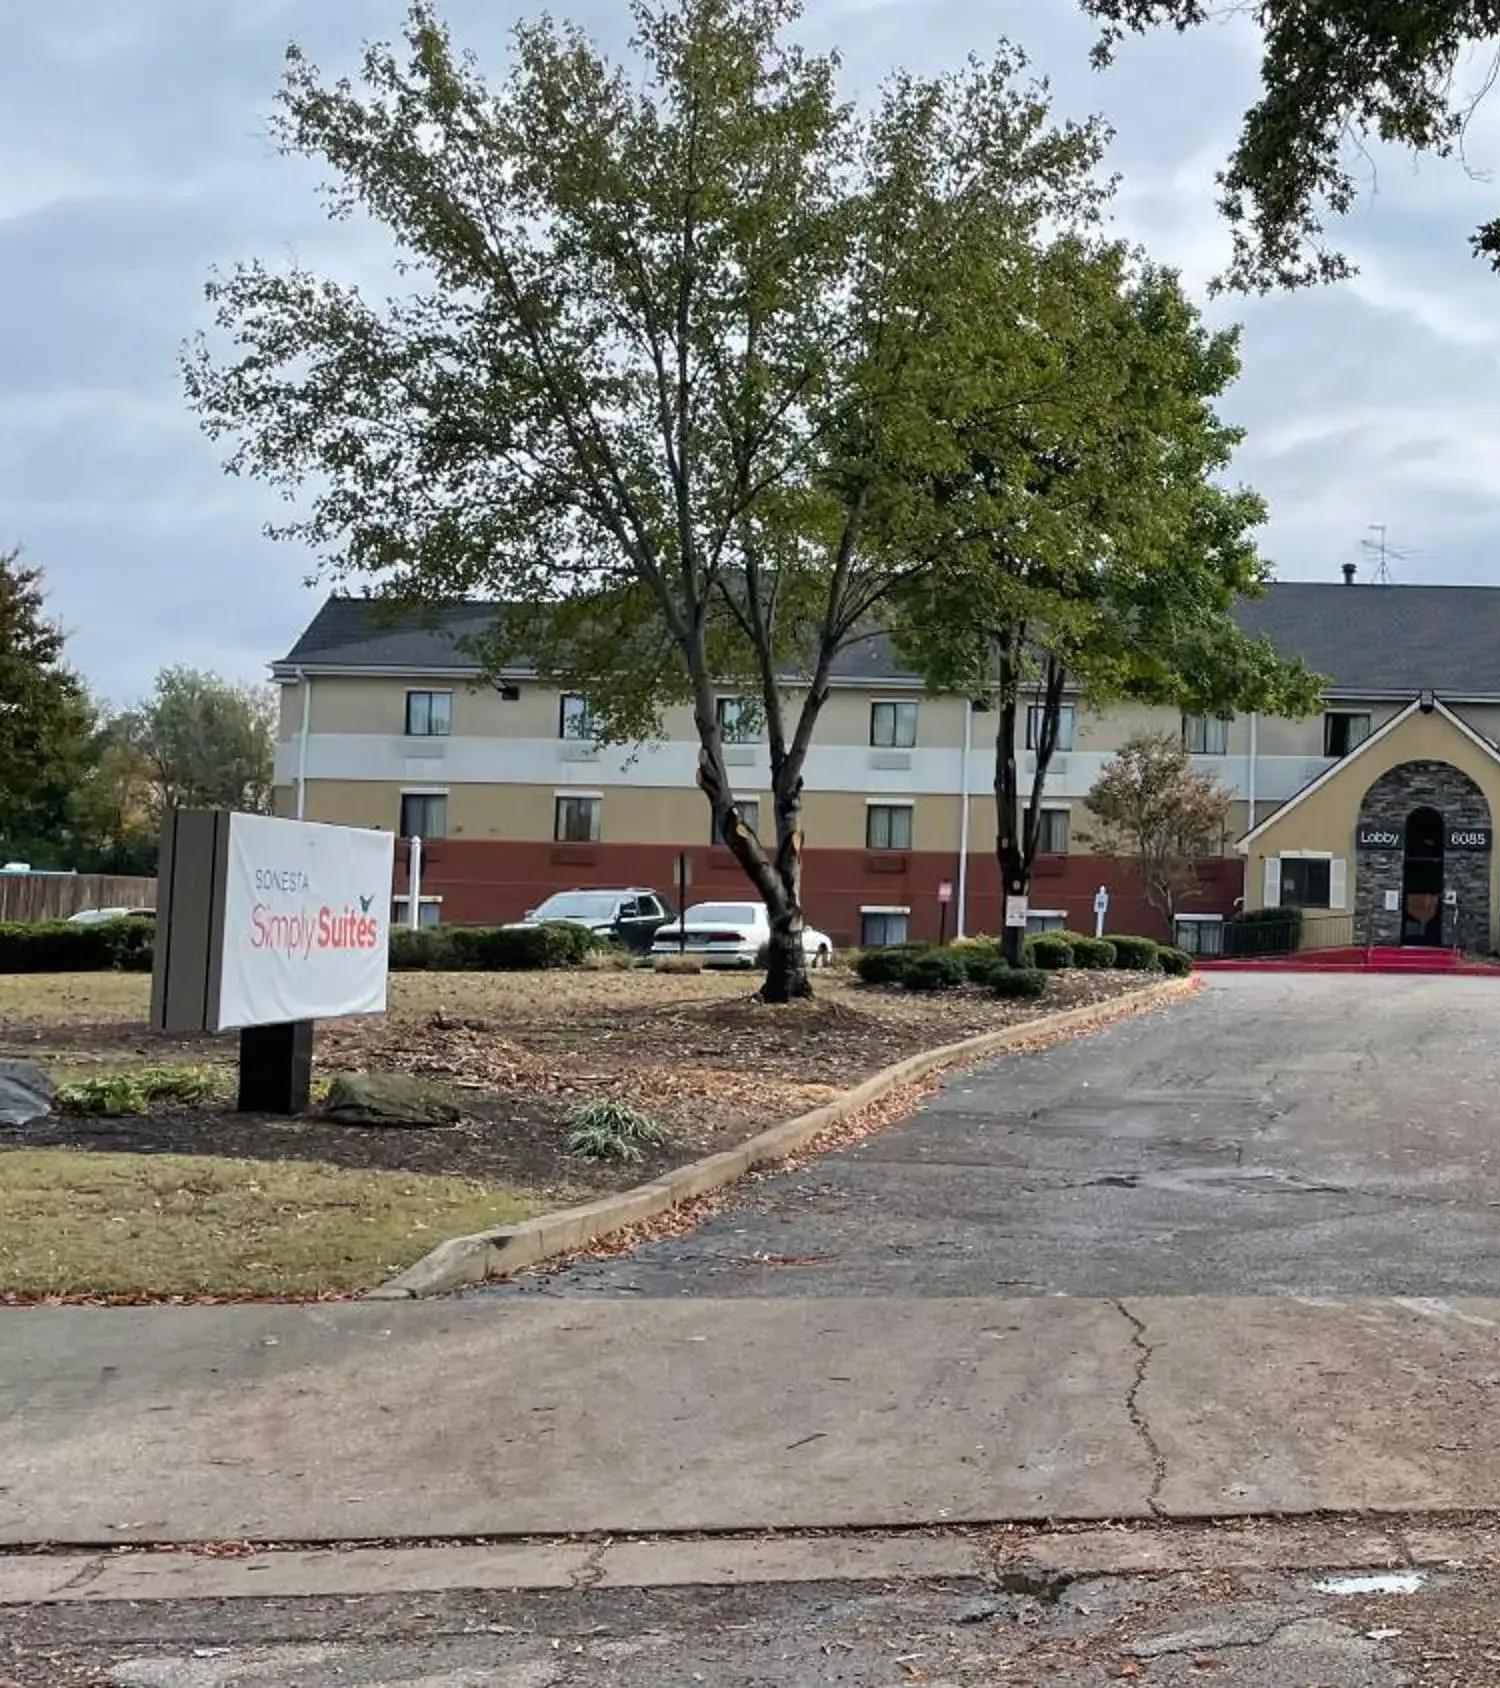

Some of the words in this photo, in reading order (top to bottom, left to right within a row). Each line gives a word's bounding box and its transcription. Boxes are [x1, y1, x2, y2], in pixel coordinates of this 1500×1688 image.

[1361, 831, 1399, 846] Lobby
[1451, 832, 1485, 845] 6085
[255, 869, 309, 892] SONESTA
[250, 903, 316, 960] Simply
[318, 906, 377, 948] Suites
